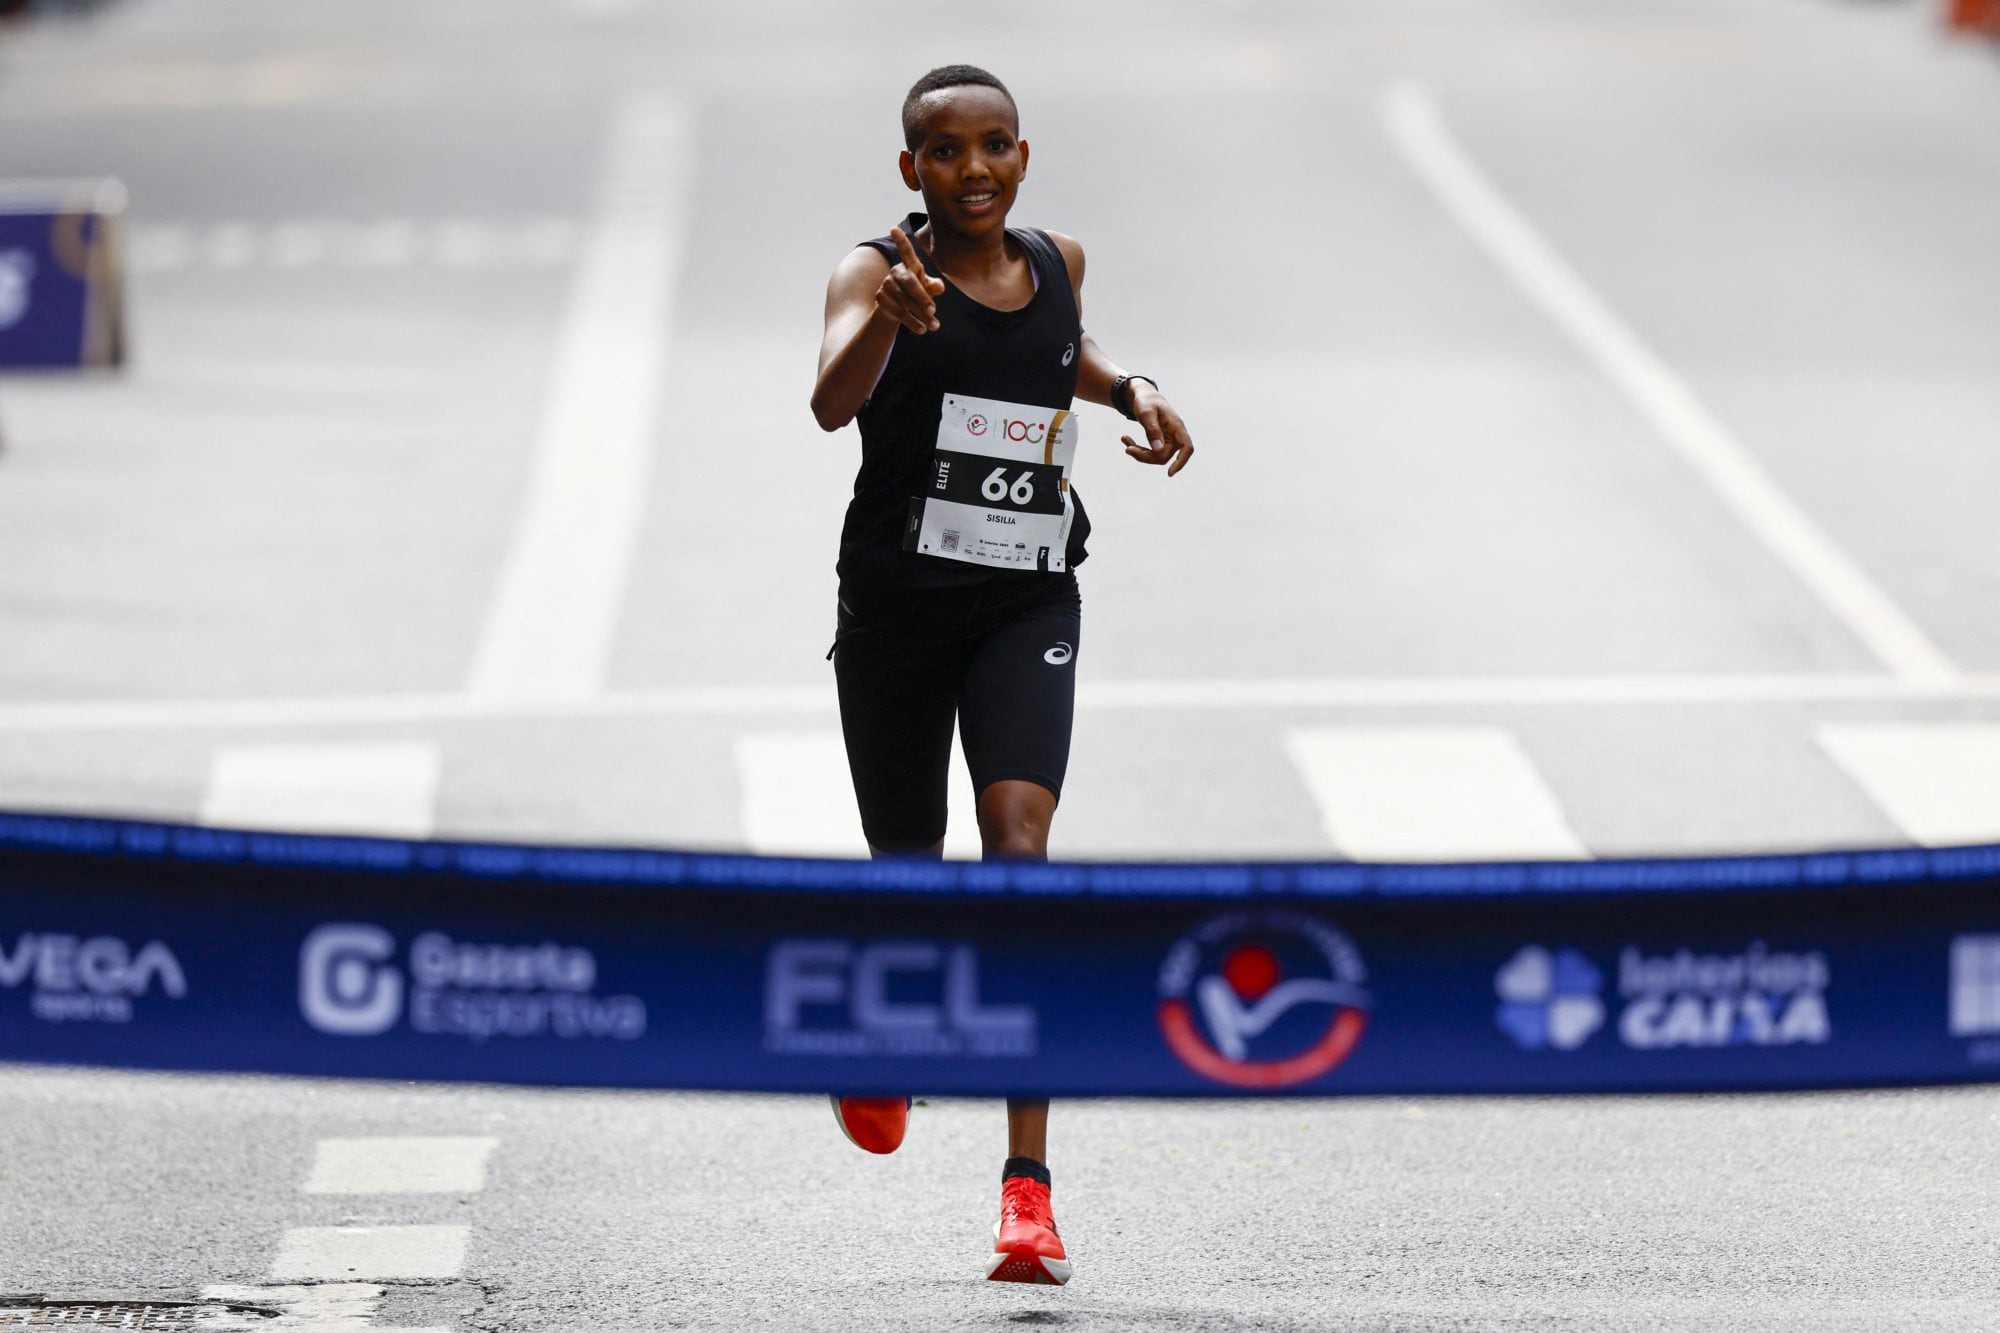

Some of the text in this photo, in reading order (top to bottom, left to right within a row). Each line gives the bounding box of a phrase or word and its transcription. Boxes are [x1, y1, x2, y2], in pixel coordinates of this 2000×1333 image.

[936, 461, 950, 490] ELITE
[981, 467, 1034, 505] 66
[986, 514, 1016, 525] SISILIA
[1040, 549, 1047, 560] F
[0, 934, 187, 998] VEGA
[766, 940, 1035, 1032] FCL
[1620, 994, 1829, 1048] CAIXA
